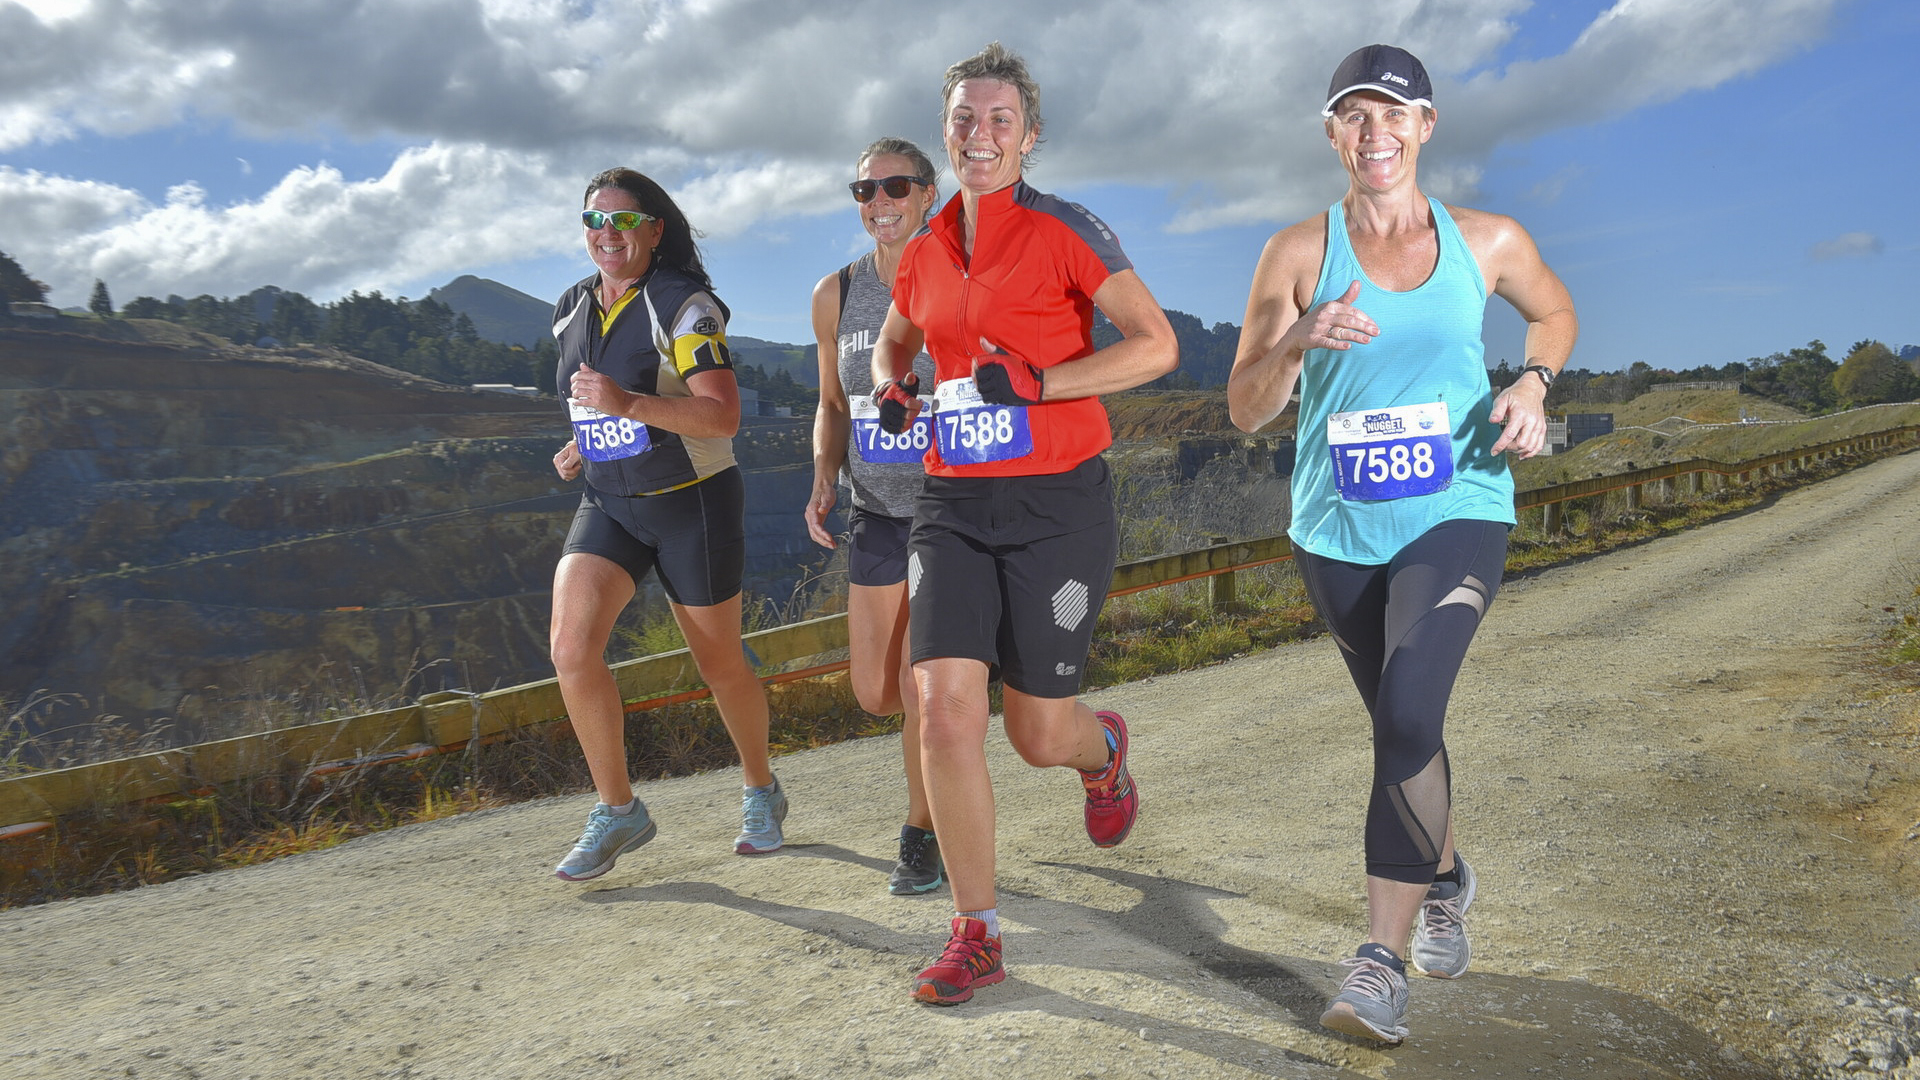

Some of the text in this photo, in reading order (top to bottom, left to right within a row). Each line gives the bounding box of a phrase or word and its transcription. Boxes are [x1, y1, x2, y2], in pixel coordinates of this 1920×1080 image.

[697, 320, 717, 333] 26
[959, 389, 981, 399] NUGG
[580, 418, 635, 450] 7588
[865, 422, 929, 450] 7588
[945, 409, 1014, 450] 7588
[1367, 418, 1402, 432] NUGGET
[1346, 442, 1435, 484] 7588
